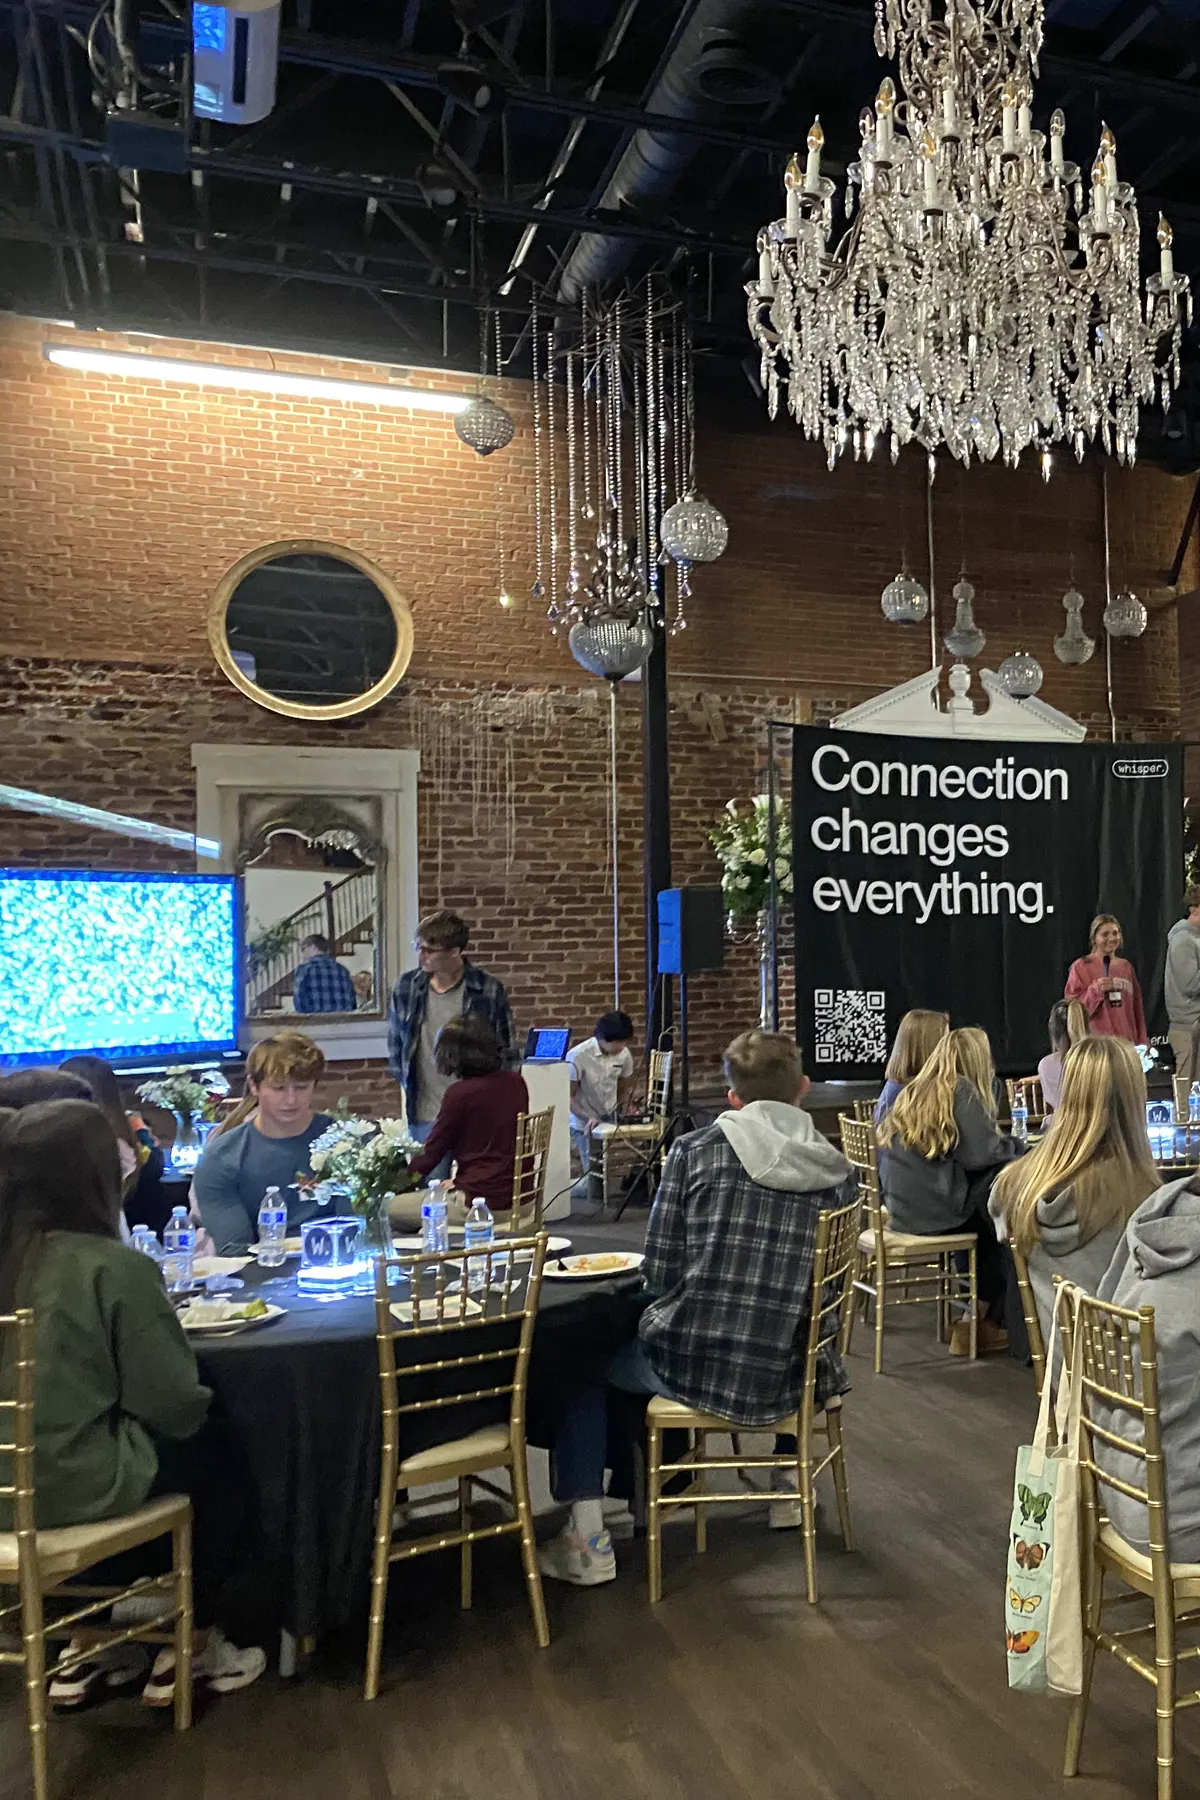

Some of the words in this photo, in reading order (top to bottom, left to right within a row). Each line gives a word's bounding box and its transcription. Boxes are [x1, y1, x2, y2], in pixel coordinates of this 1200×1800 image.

[811, 744, 1069, 801] Connection
[810, 807, 1010, 867] changes
[812, 871, 1055, 925] everything.
[311, 1236, 330, 1256] W.
